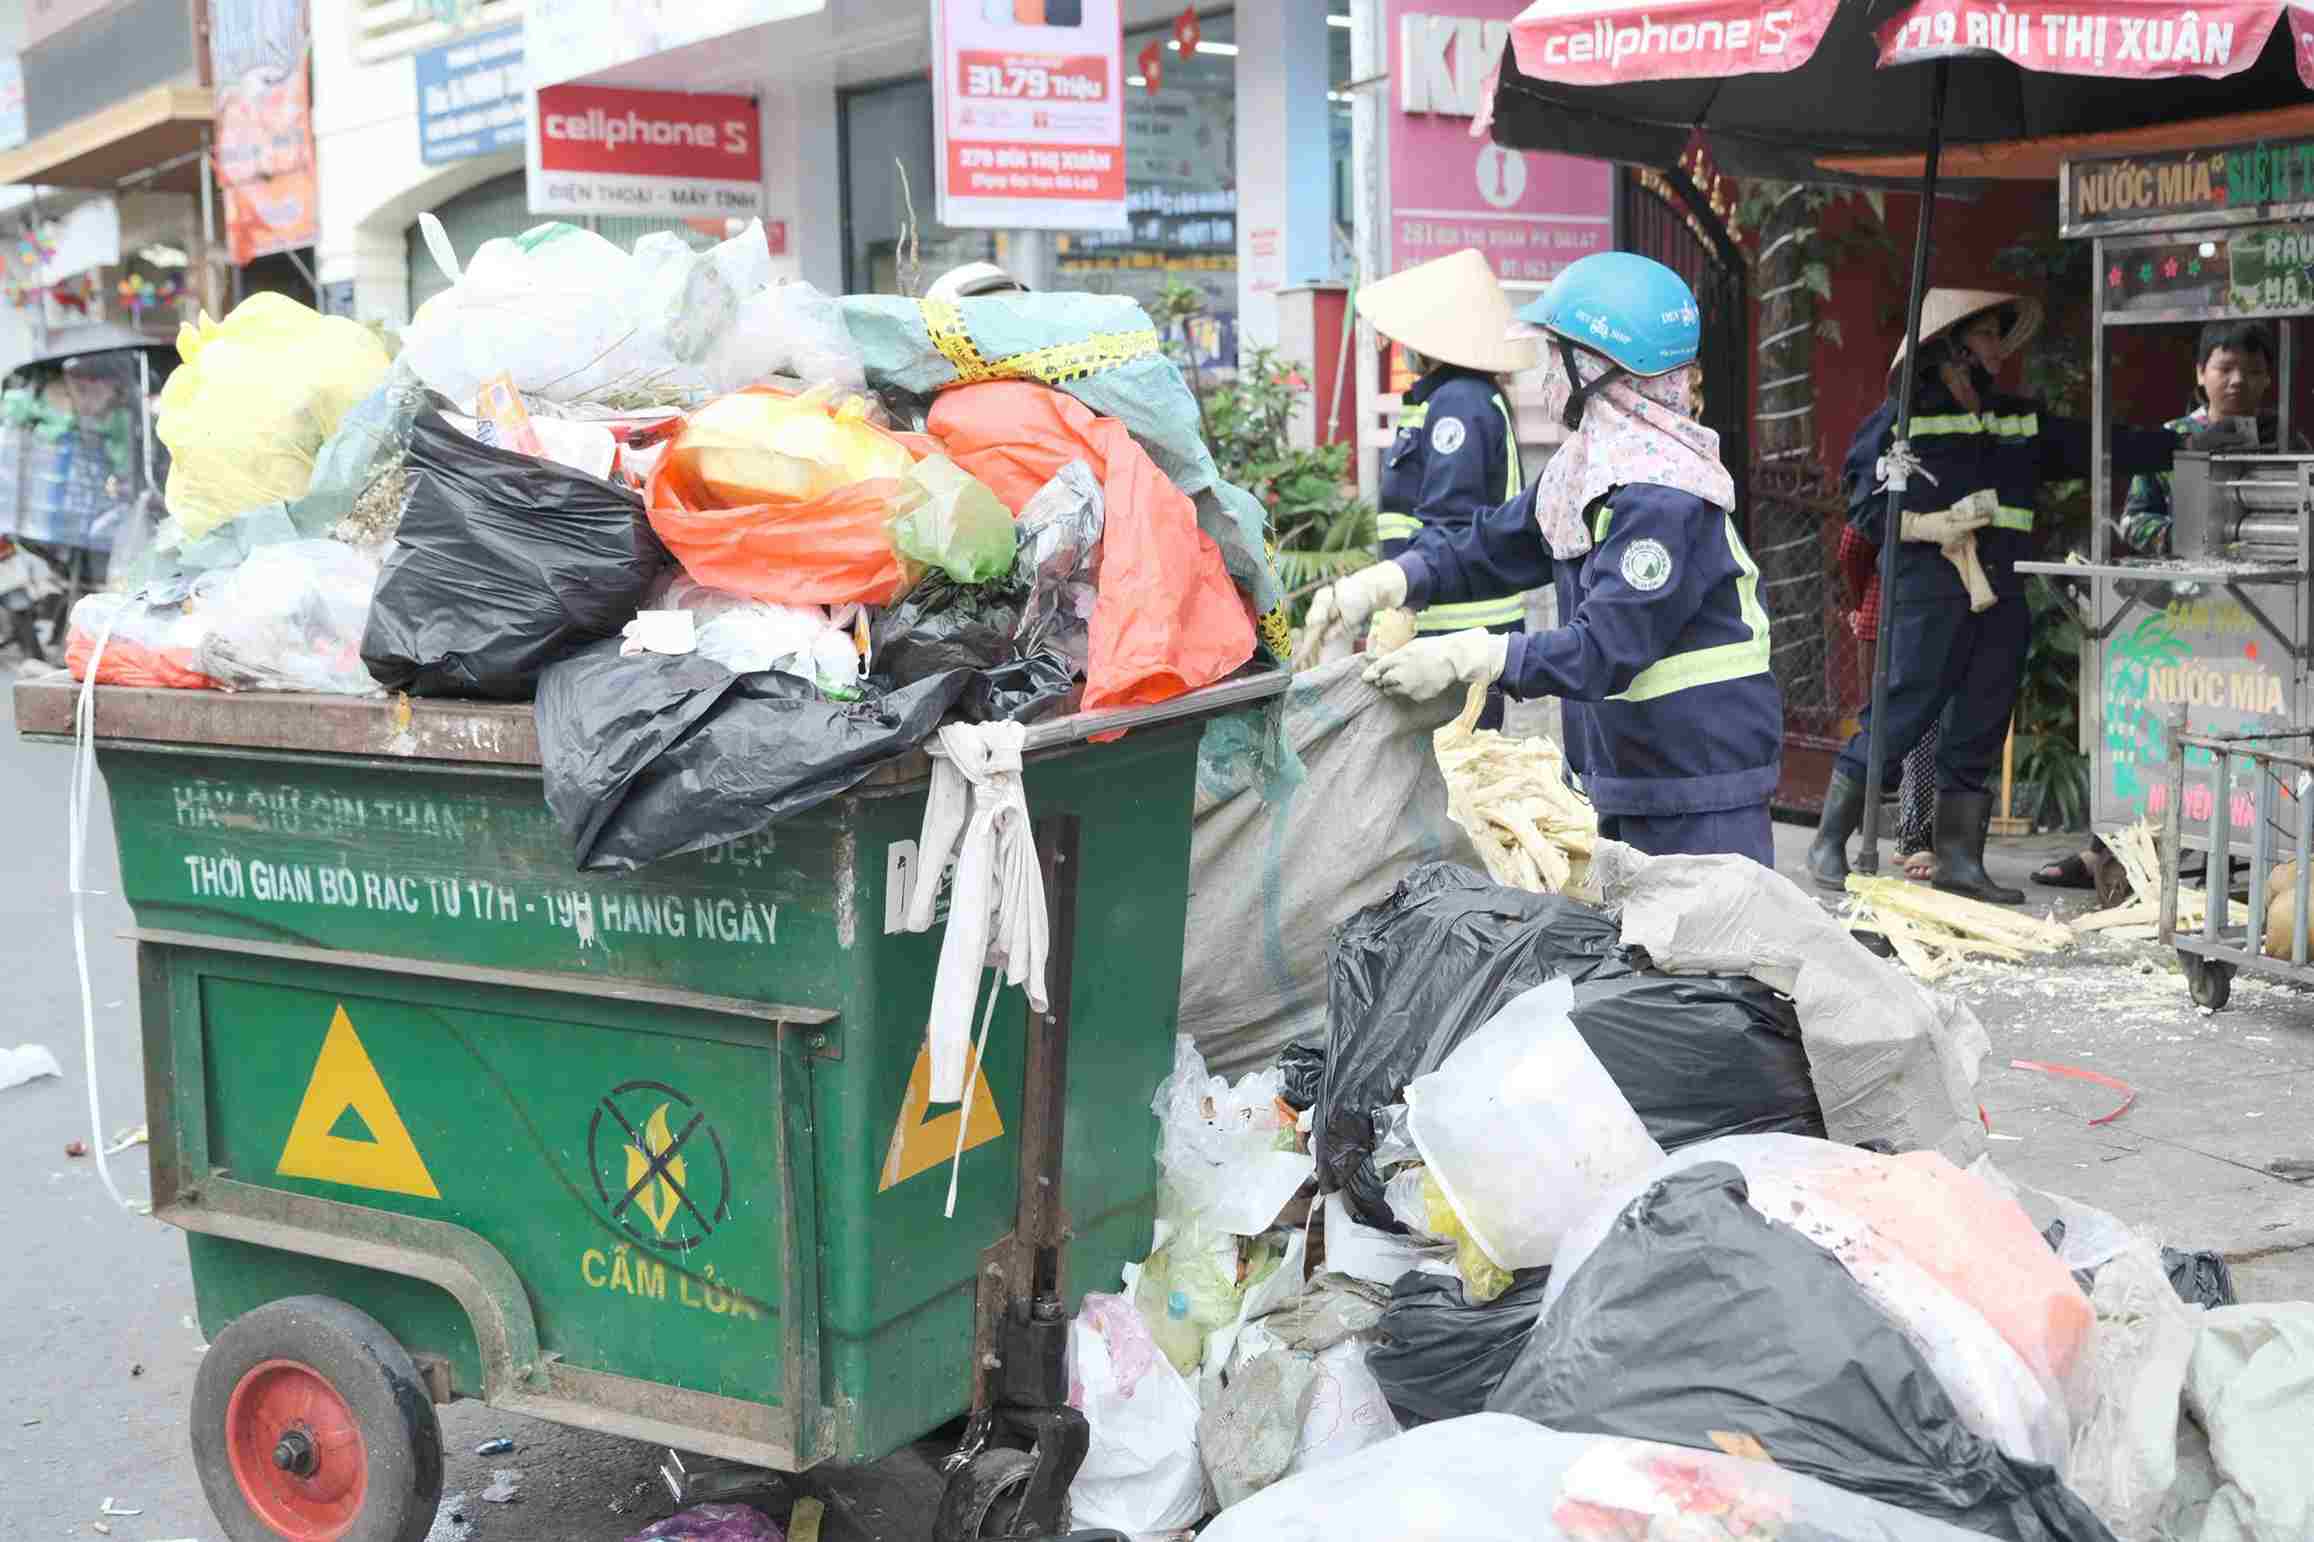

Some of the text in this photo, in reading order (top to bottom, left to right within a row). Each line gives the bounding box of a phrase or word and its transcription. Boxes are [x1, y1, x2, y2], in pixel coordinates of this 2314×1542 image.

[1544, 15, 1751, 68] cellphone
[2042, 16, 2107, 66] THỊ
[2115, 10, 2235, 65] XUÂN
[967, 64, 1048, 98] 31.79
[544, 108, 717, 152] cellphone
[2078, 159, 2154, 216] NƯỚC
[2157, 152, 2213, 206] MÍA
[2229, 663, 2287, 716] MÍA
[184, 848, 246, 898] THỜI
[250, 859, 315, 904] GIAN
[468, 877, 518, 922] 17H
[695, 887, 777, 945] NGÀY
